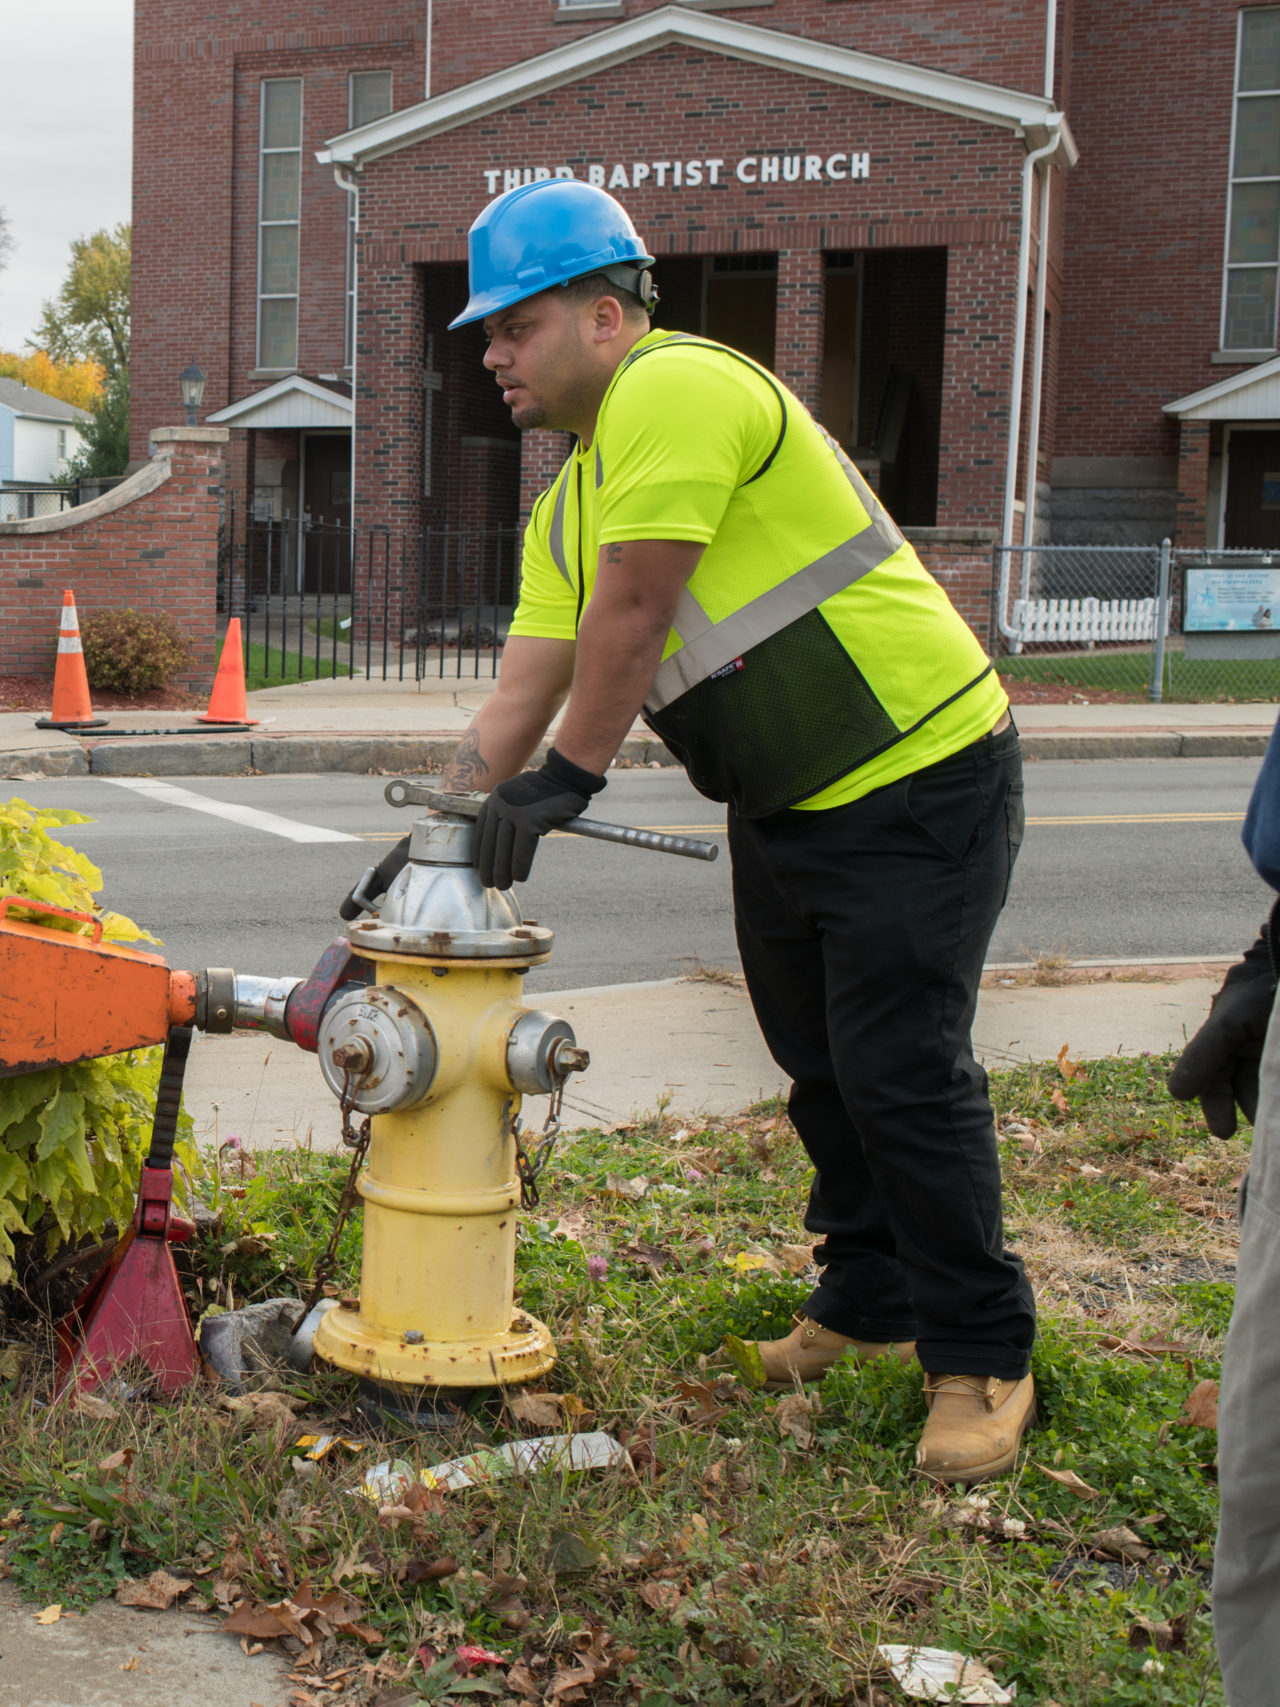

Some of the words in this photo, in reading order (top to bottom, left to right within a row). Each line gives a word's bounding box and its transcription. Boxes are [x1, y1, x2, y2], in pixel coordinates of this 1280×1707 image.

[483, 166, 574, 194] THIRD
[589, 159, 724, 189] BAPTIST
[736, 152, 870, 183] CHURCH
